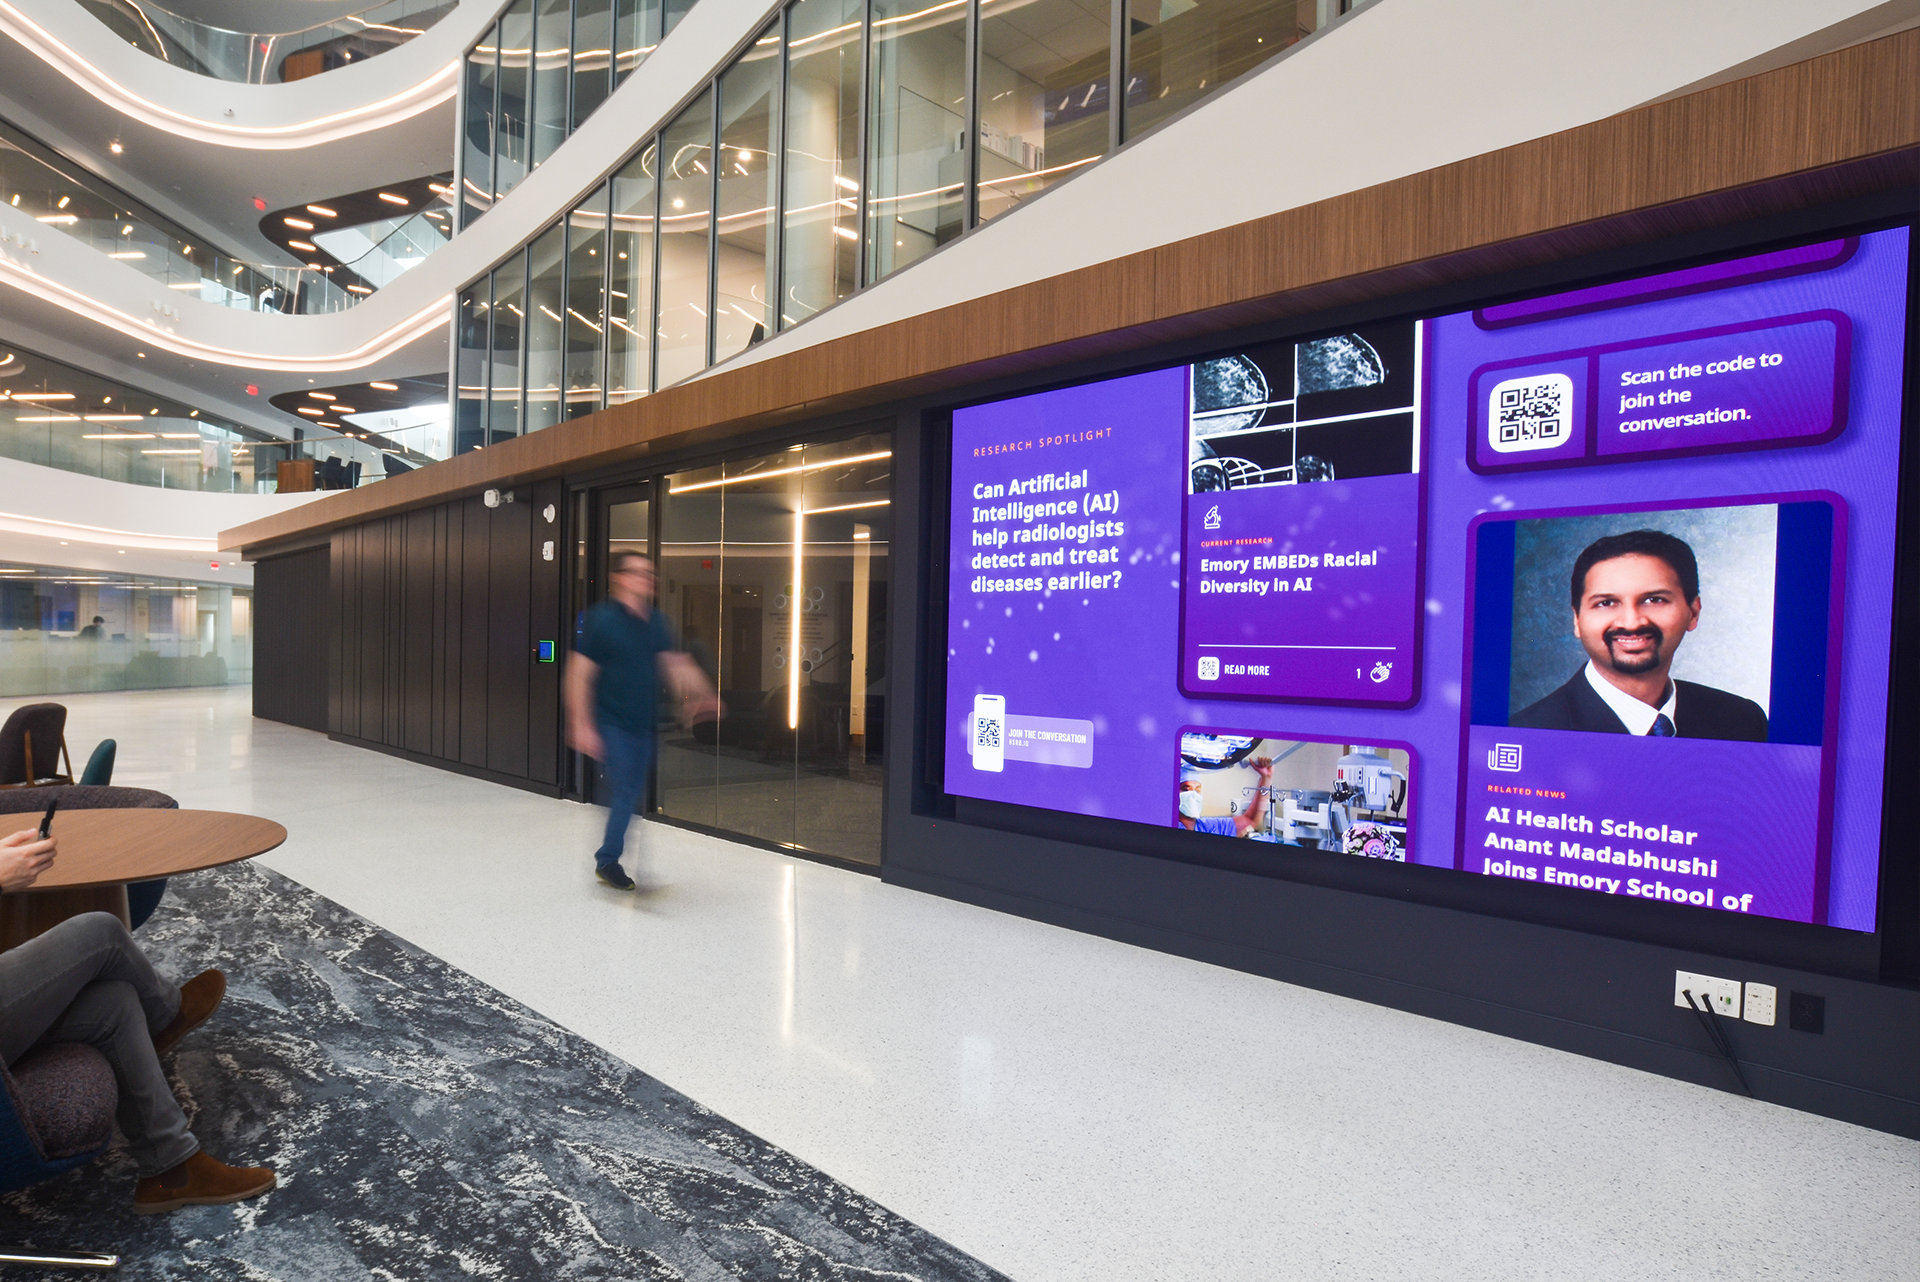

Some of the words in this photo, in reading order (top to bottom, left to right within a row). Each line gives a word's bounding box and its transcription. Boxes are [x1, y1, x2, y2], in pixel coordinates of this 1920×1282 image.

[1620, 369, 1665, 386] Scan
[1668, 364, 1702, 380] the
[1706, 356, 1756, 376] code
[1759, 352, 1782, 368] to
[1618, 394, 1654, 414] join
[1658, 388, 1692, 405] the
[1619, 407, 1751, 434] conversation.
[973, 440, 1032, 457] RESEARCH
[1039, 428, 1112, 448] SPOTLIGHT
[973, 483, 1004, 499] Can
[1008, 469, 1088, 496] Artificial
[972, 499, 1078, 523] Intelligence
[1083, 490, 1119, 516] (AI)
[972, 529, 1008, 549] help
[1013, 520, 1124, 544] radiologists
[1236, 537, 1273, 545] RESEARCH
[972, 552, 1025, 569] detect
[1030, 548, 1064, 566] and
[1069, 546, 1119, 563] treat
[1201, 558, 1250, 574] Emory
[1253, 555, 1318, 570] EMBEDs
[1324, 550, 1377, 567] Racial
[971, 575, 1042, 593] diseases
[1048, 571, 1122, 590] earlier?
[1200, 578, 1270, 596] Diversity
[1274, 578, 1289, 592] in
[1293, 578, 1312, 592] AI
[1224, 665, 1245, 675] READ
[1247, 666, 1270, 676] MORE
[1356, 668, 1361, 679] 1
[1008, 729, 1022, 737] JOIN
[1024, 730, 1036, 739] THE
[1038, 731, 1086, 744] CONVERSATION
[1487, 785, 1532, 797] RELATED
[1536, 789, 1567, 799] NEWS
[1485, 807, 1510, 824] AI
[1516, 810, 1593, 834] Health
[1600, 819, 1698, 846] Scholar
[1484, 832, 1553, 856] Anant
[1559, 842, 1718, 878] Madabhushi
[1482, 859, 1537, 881] Joins
[1543, 867, 1621, 895] Emory
[1626, 878, 1714, 907] School
[1722, 893, 1753, 912] of
